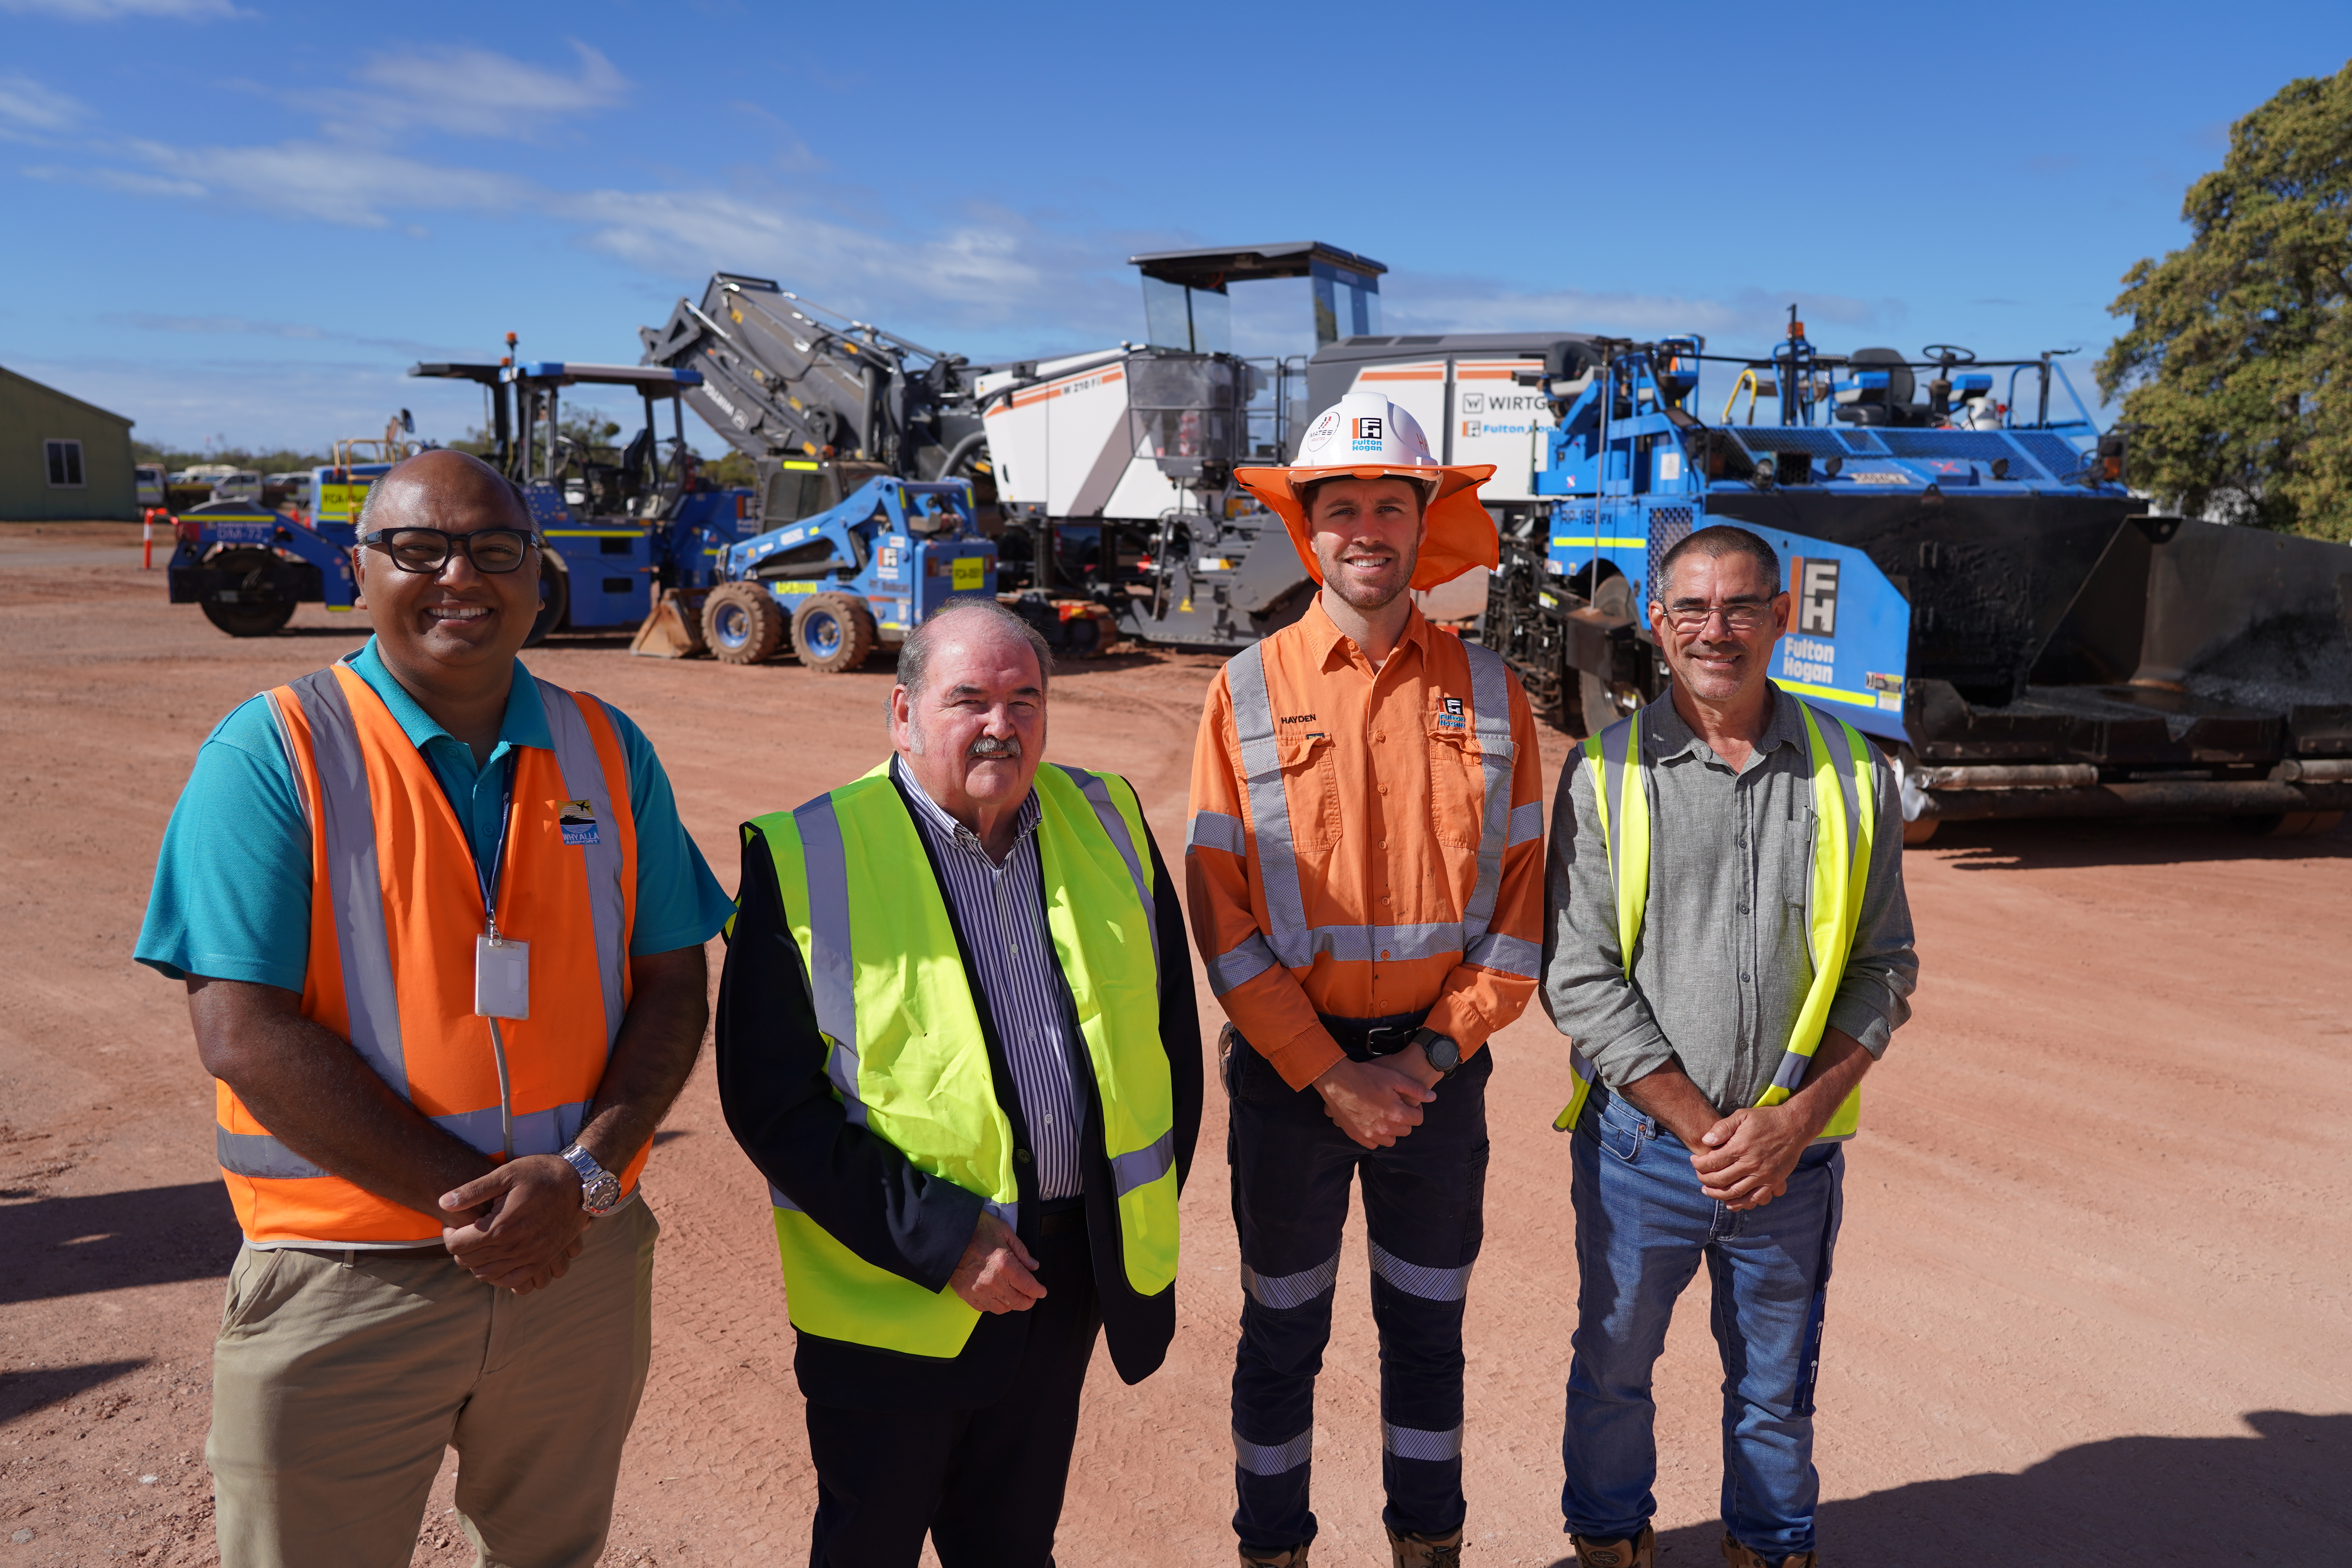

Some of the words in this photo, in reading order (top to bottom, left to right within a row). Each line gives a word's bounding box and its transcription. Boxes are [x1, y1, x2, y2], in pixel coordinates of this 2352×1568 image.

[1489, 397, 1545, 410] WIRTG
[1309, 430, 1333, 438] MATES
[1483, 425, 1525, 433] Fulton
[1784, 637, 1835, 663] Fulton
[1783, 657, 1833, 684] Hogan
[1281, 714, 1316, 724] HAYDEN
[1439, 714, 1465, 722] Fulton
[1439, 720, 1465, 728] Hogan
[563, 831, 600, 841] WHYALLA
